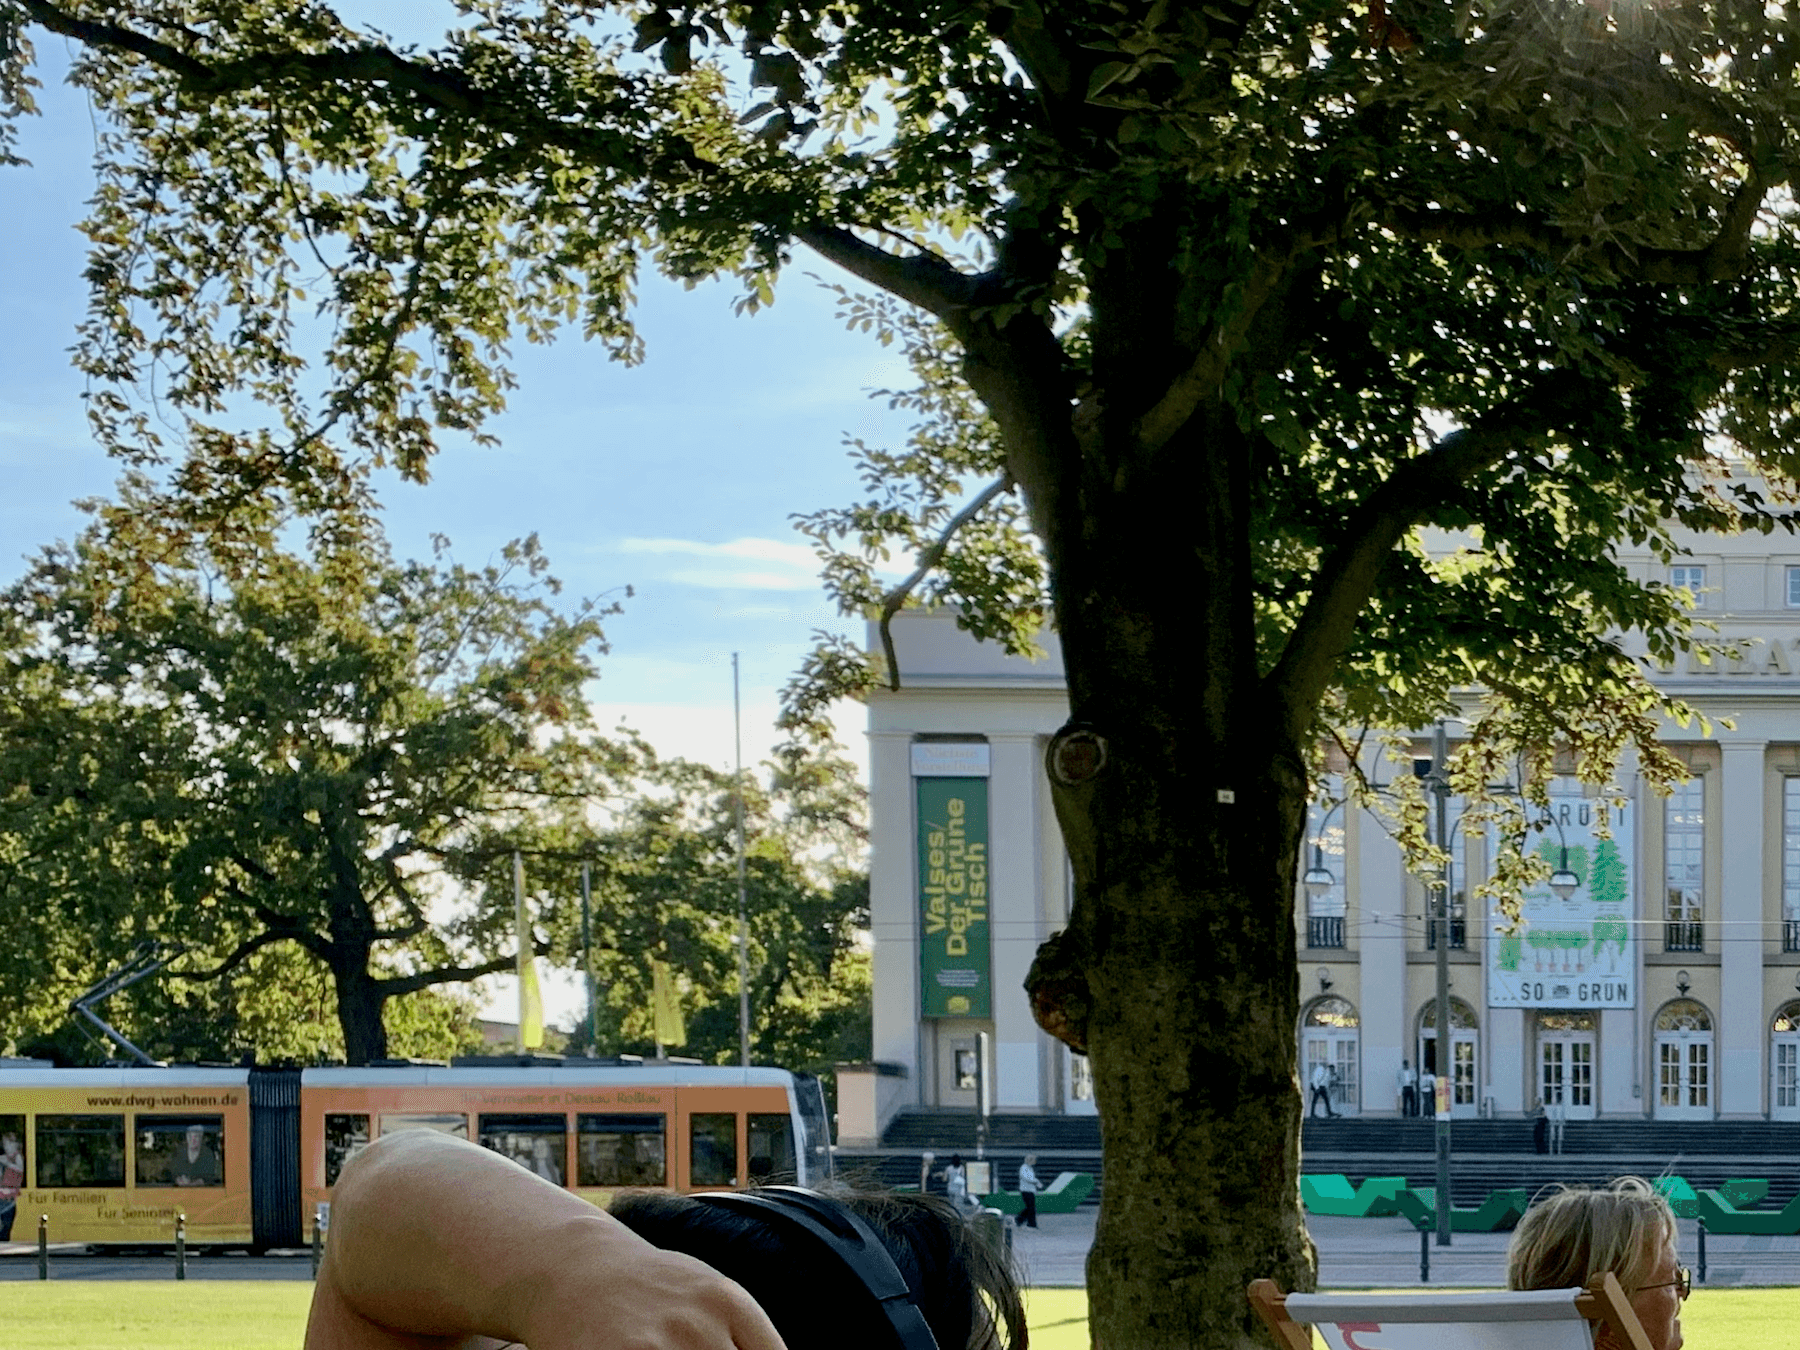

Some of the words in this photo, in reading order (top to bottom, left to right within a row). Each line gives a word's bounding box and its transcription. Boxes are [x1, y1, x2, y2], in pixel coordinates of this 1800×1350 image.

[963, 843, 986, 927] Tisch
[946, 901, 968, 956] Der
[87, 1093, 239, 1108] www.dwg-wohnen.de
[53, 1191, 107, 1204] Familien
